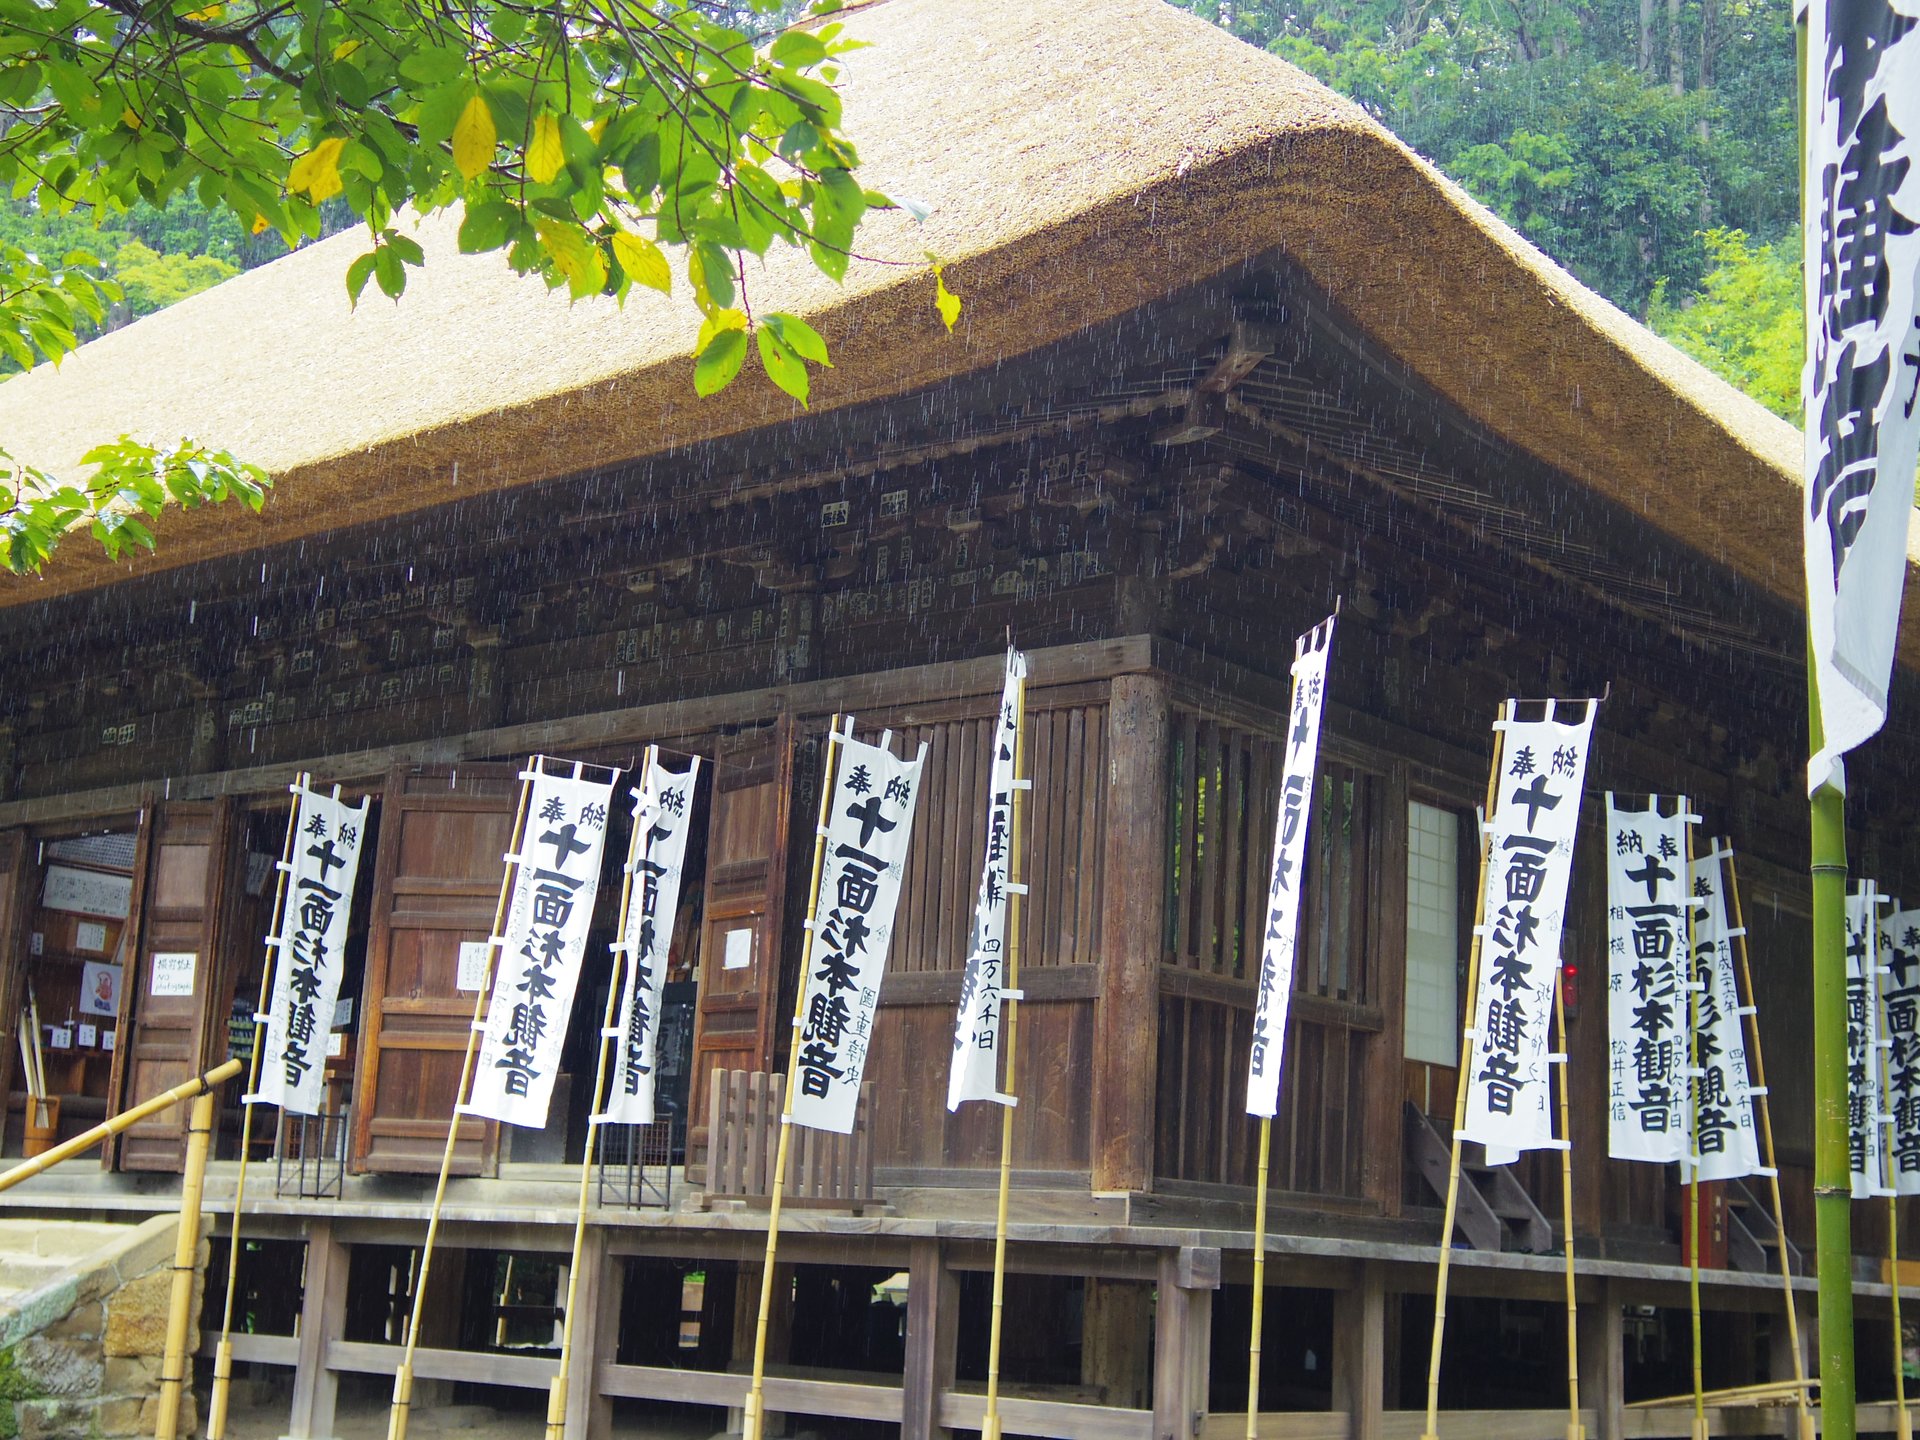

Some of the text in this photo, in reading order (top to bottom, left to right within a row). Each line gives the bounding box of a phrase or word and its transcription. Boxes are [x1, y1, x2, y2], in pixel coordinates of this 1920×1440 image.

[977, 937, 1002, 1052] 四万六千日
[1625, 853, 1678, 1135] 十一面杉本観音
[1717, 940, 1739, 1016] 平成二十六年
[1729, 1048, 1752, 1128] 四万六千日
